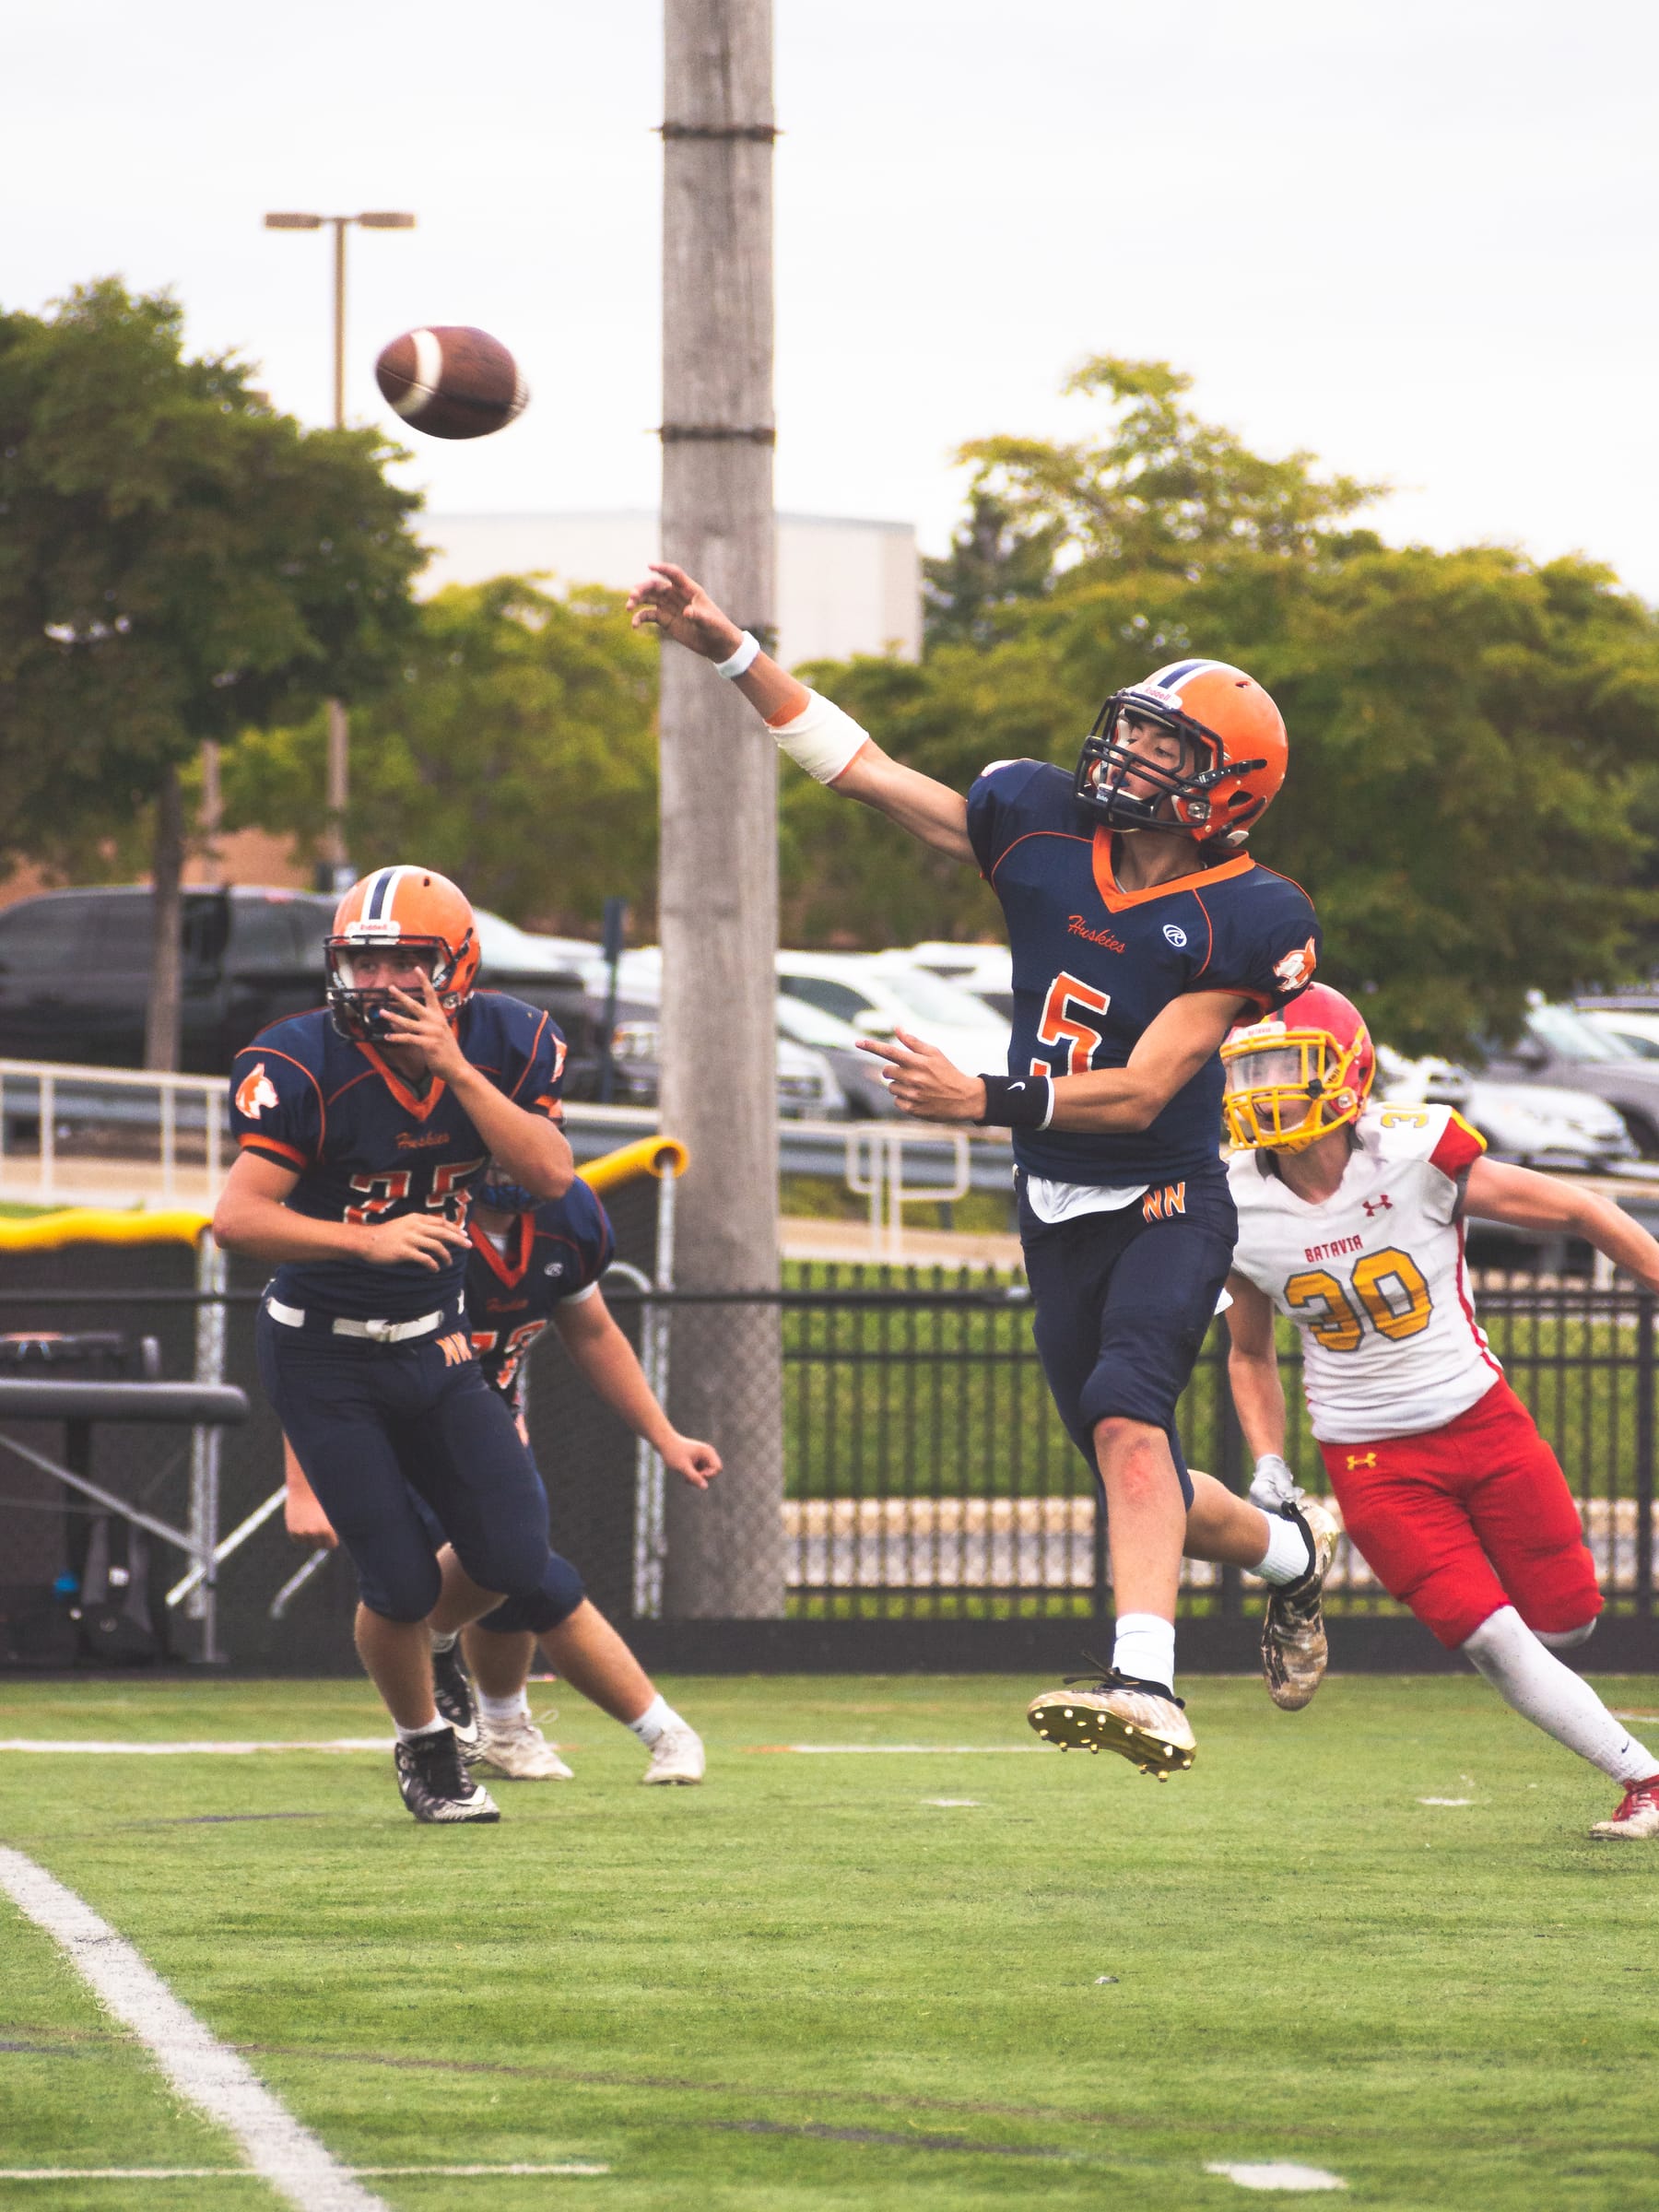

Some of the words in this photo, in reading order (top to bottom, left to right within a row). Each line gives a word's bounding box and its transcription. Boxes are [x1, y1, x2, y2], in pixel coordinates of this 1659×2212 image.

[1068, 914, 1126, 954] Huskies
[1030, 971, 1112, 1077] 5
[344, 1156, 486, 1230] 25
[1143, 1182, 1186, 1223] NN
[1305, 1234, 1363, 1263] BATAVIA
[1283, 1245, 1435, 1352] 30
